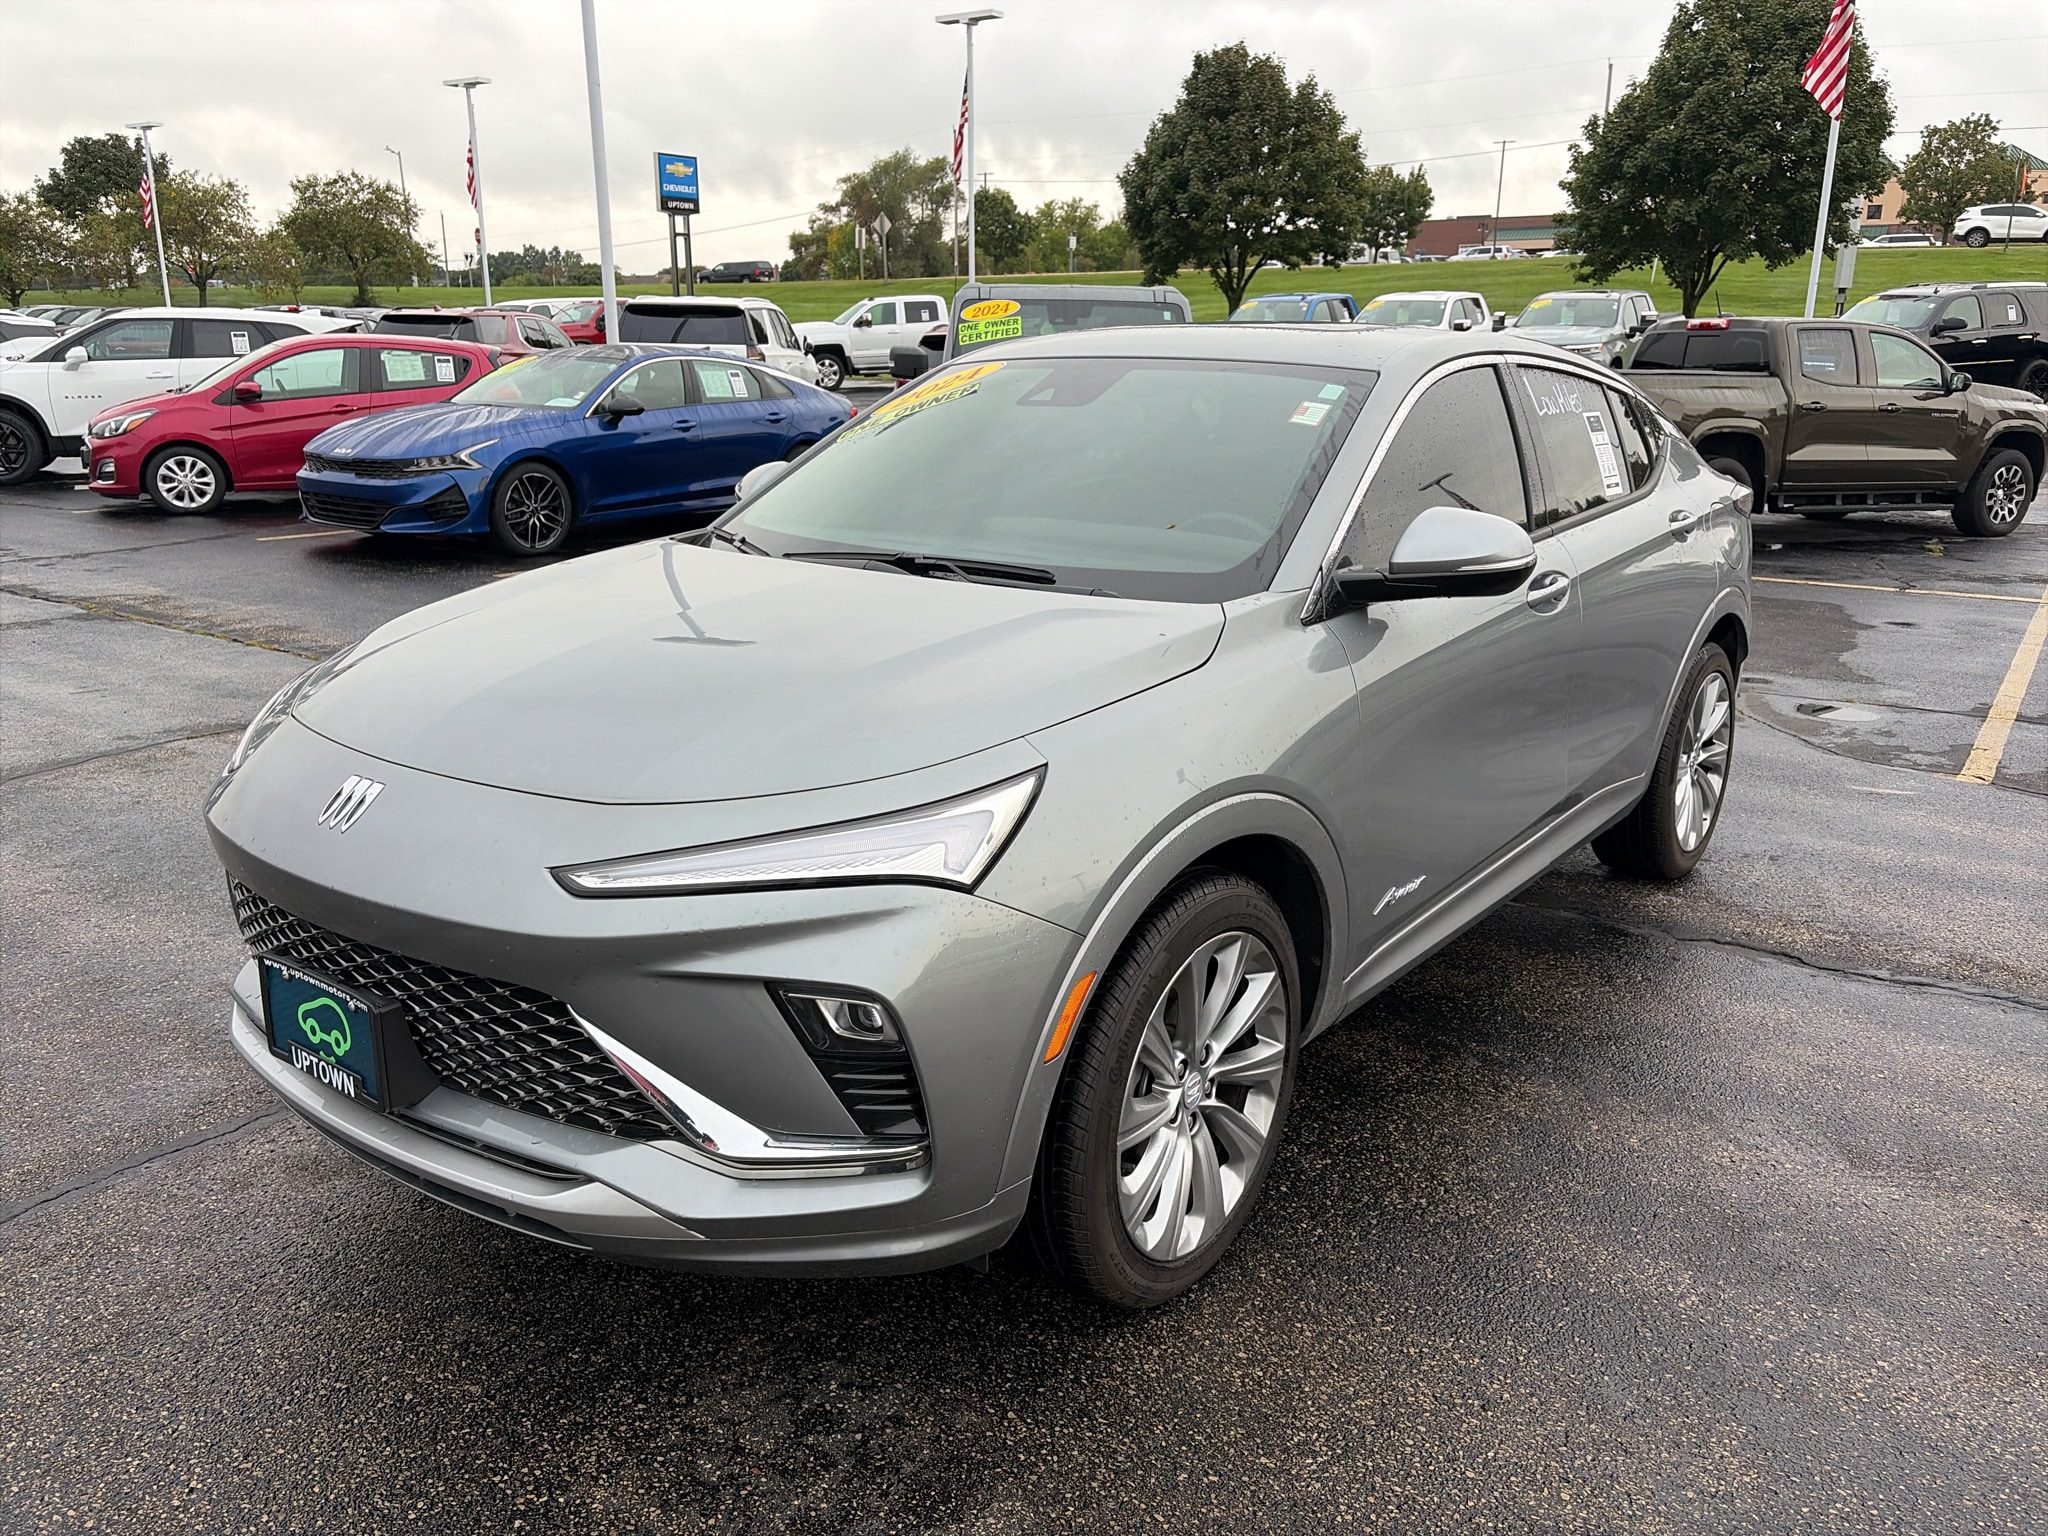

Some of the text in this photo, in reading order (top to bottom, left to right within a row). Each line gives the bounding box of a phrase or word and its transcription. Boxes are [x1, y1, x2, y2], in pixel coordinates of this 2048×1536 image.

[663, 183, 696, 193] CHEVROLET
[667, 201, 694, 209] UPTOWN
[971, 302, 1010, 319] 2024
[960, 318, 1019, 333] ONE OWNER
[960, 327, 1019, 343] CERTIFIED
[894, 366, 985, 408] 2024
[291, 1045, 355, 1098] UPTOWN
